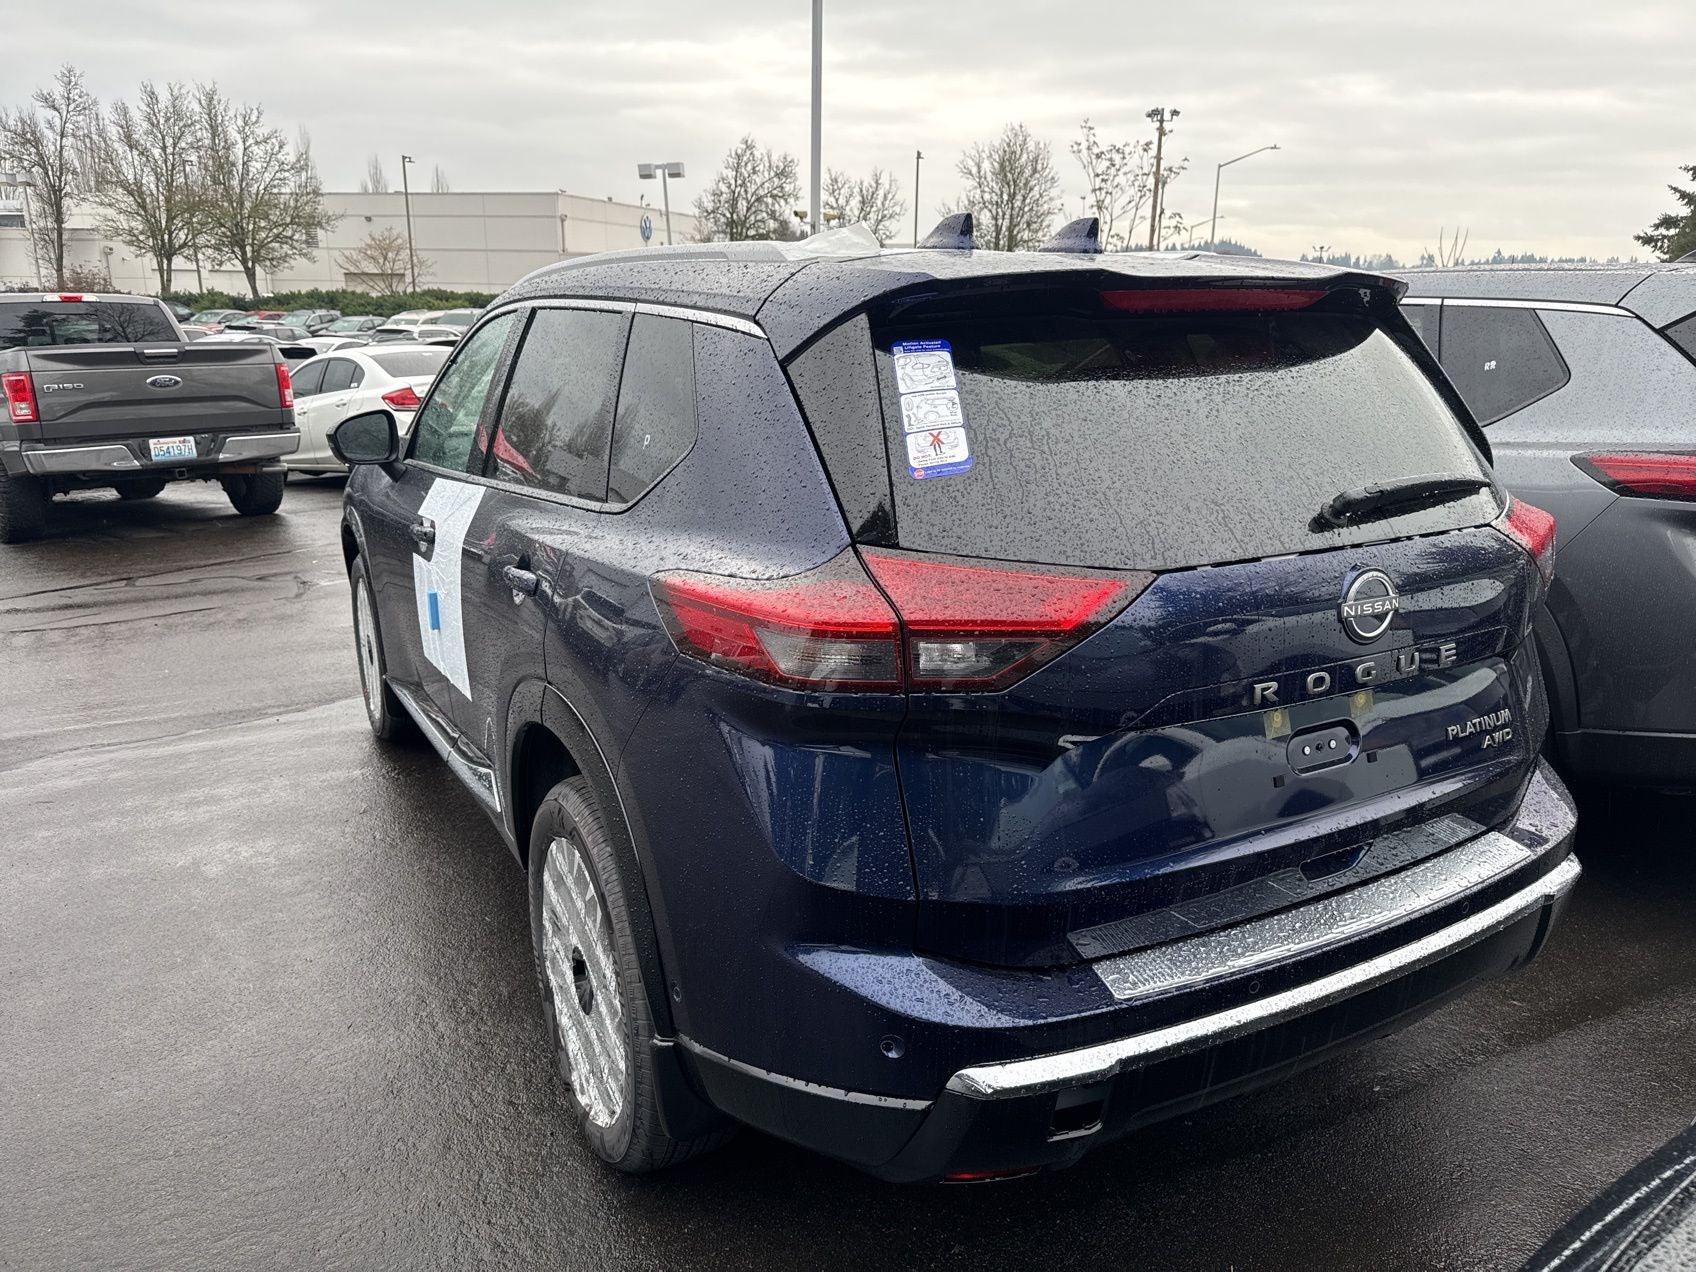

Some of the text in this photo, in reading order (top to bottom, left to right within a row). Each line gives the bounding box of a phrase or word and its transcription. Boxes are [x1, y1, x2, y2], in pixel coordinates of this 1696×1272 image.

[1343, 597, 1399, 617] NISSAN
[1253, 643, 1457, 705] ROGUE
[1446, 708, 1512, 741] PLATINUM
[1481, 727, 1512, 749] AWD
